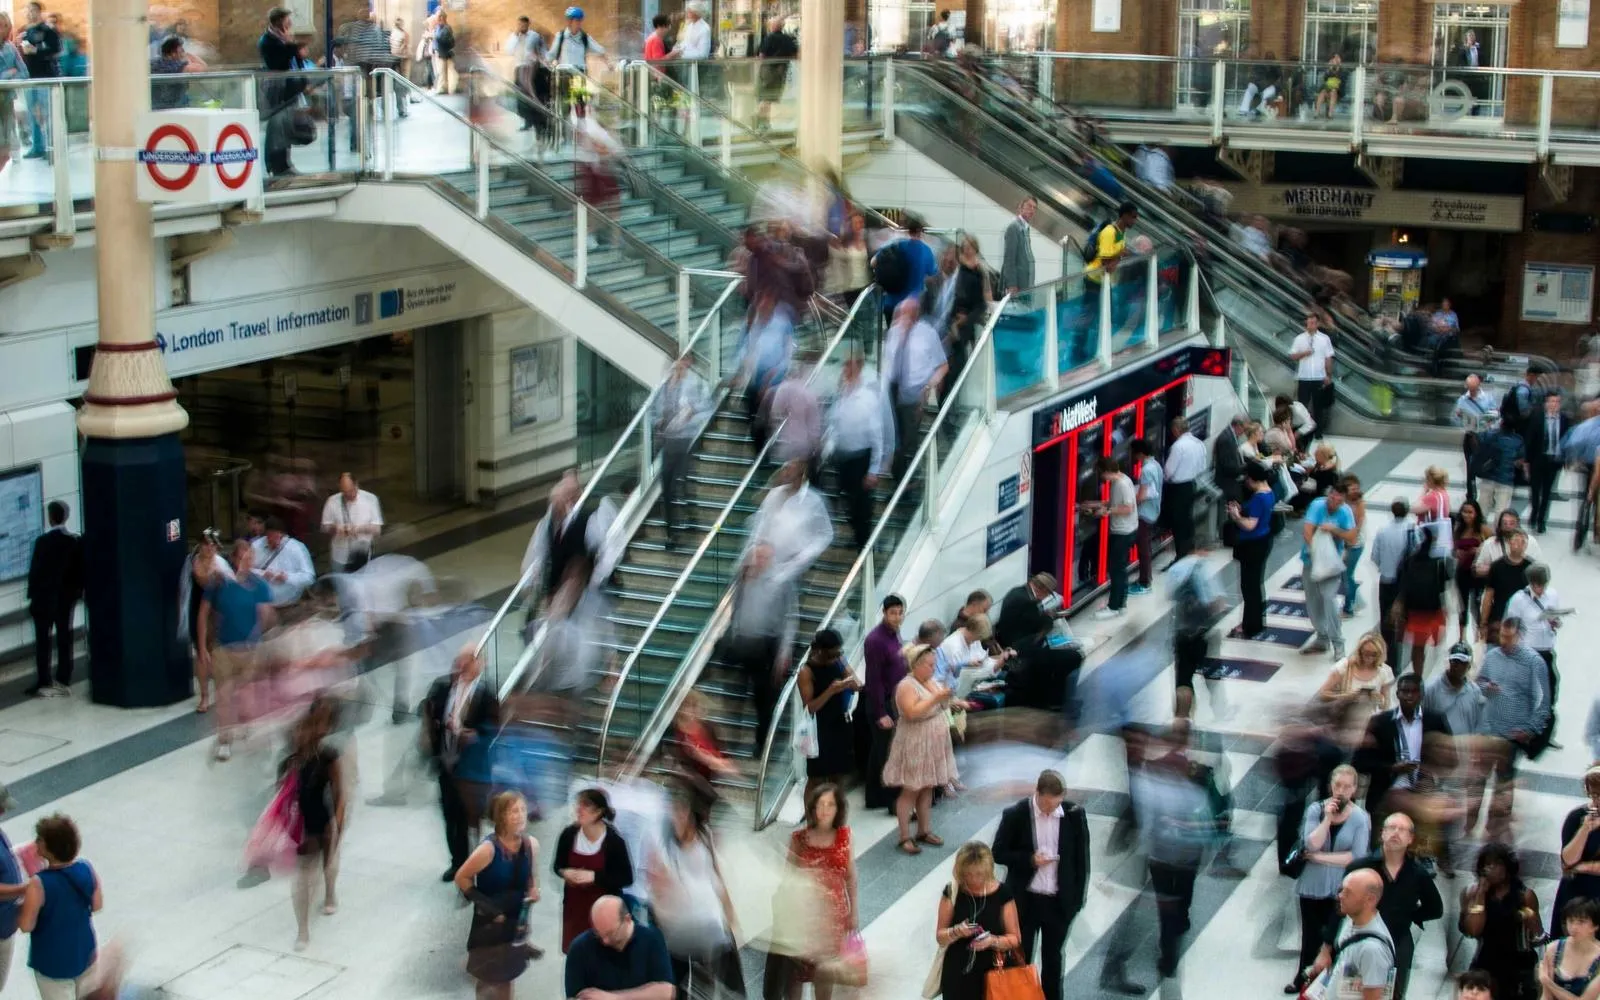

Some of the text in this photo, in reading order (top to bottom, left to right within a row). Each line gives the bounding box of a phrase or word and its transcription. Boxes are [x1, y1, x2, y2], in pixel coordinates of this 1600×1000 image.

[142, 153, 203, 162] UNDERGROUND
[213, 150, 256, 162] UNDERGROUND
[1285, 188, 1375, 208] MERCHANT
[172, 305, 350, 353] London Travel Information
[1062, 395, 1097, 432] NatWest
